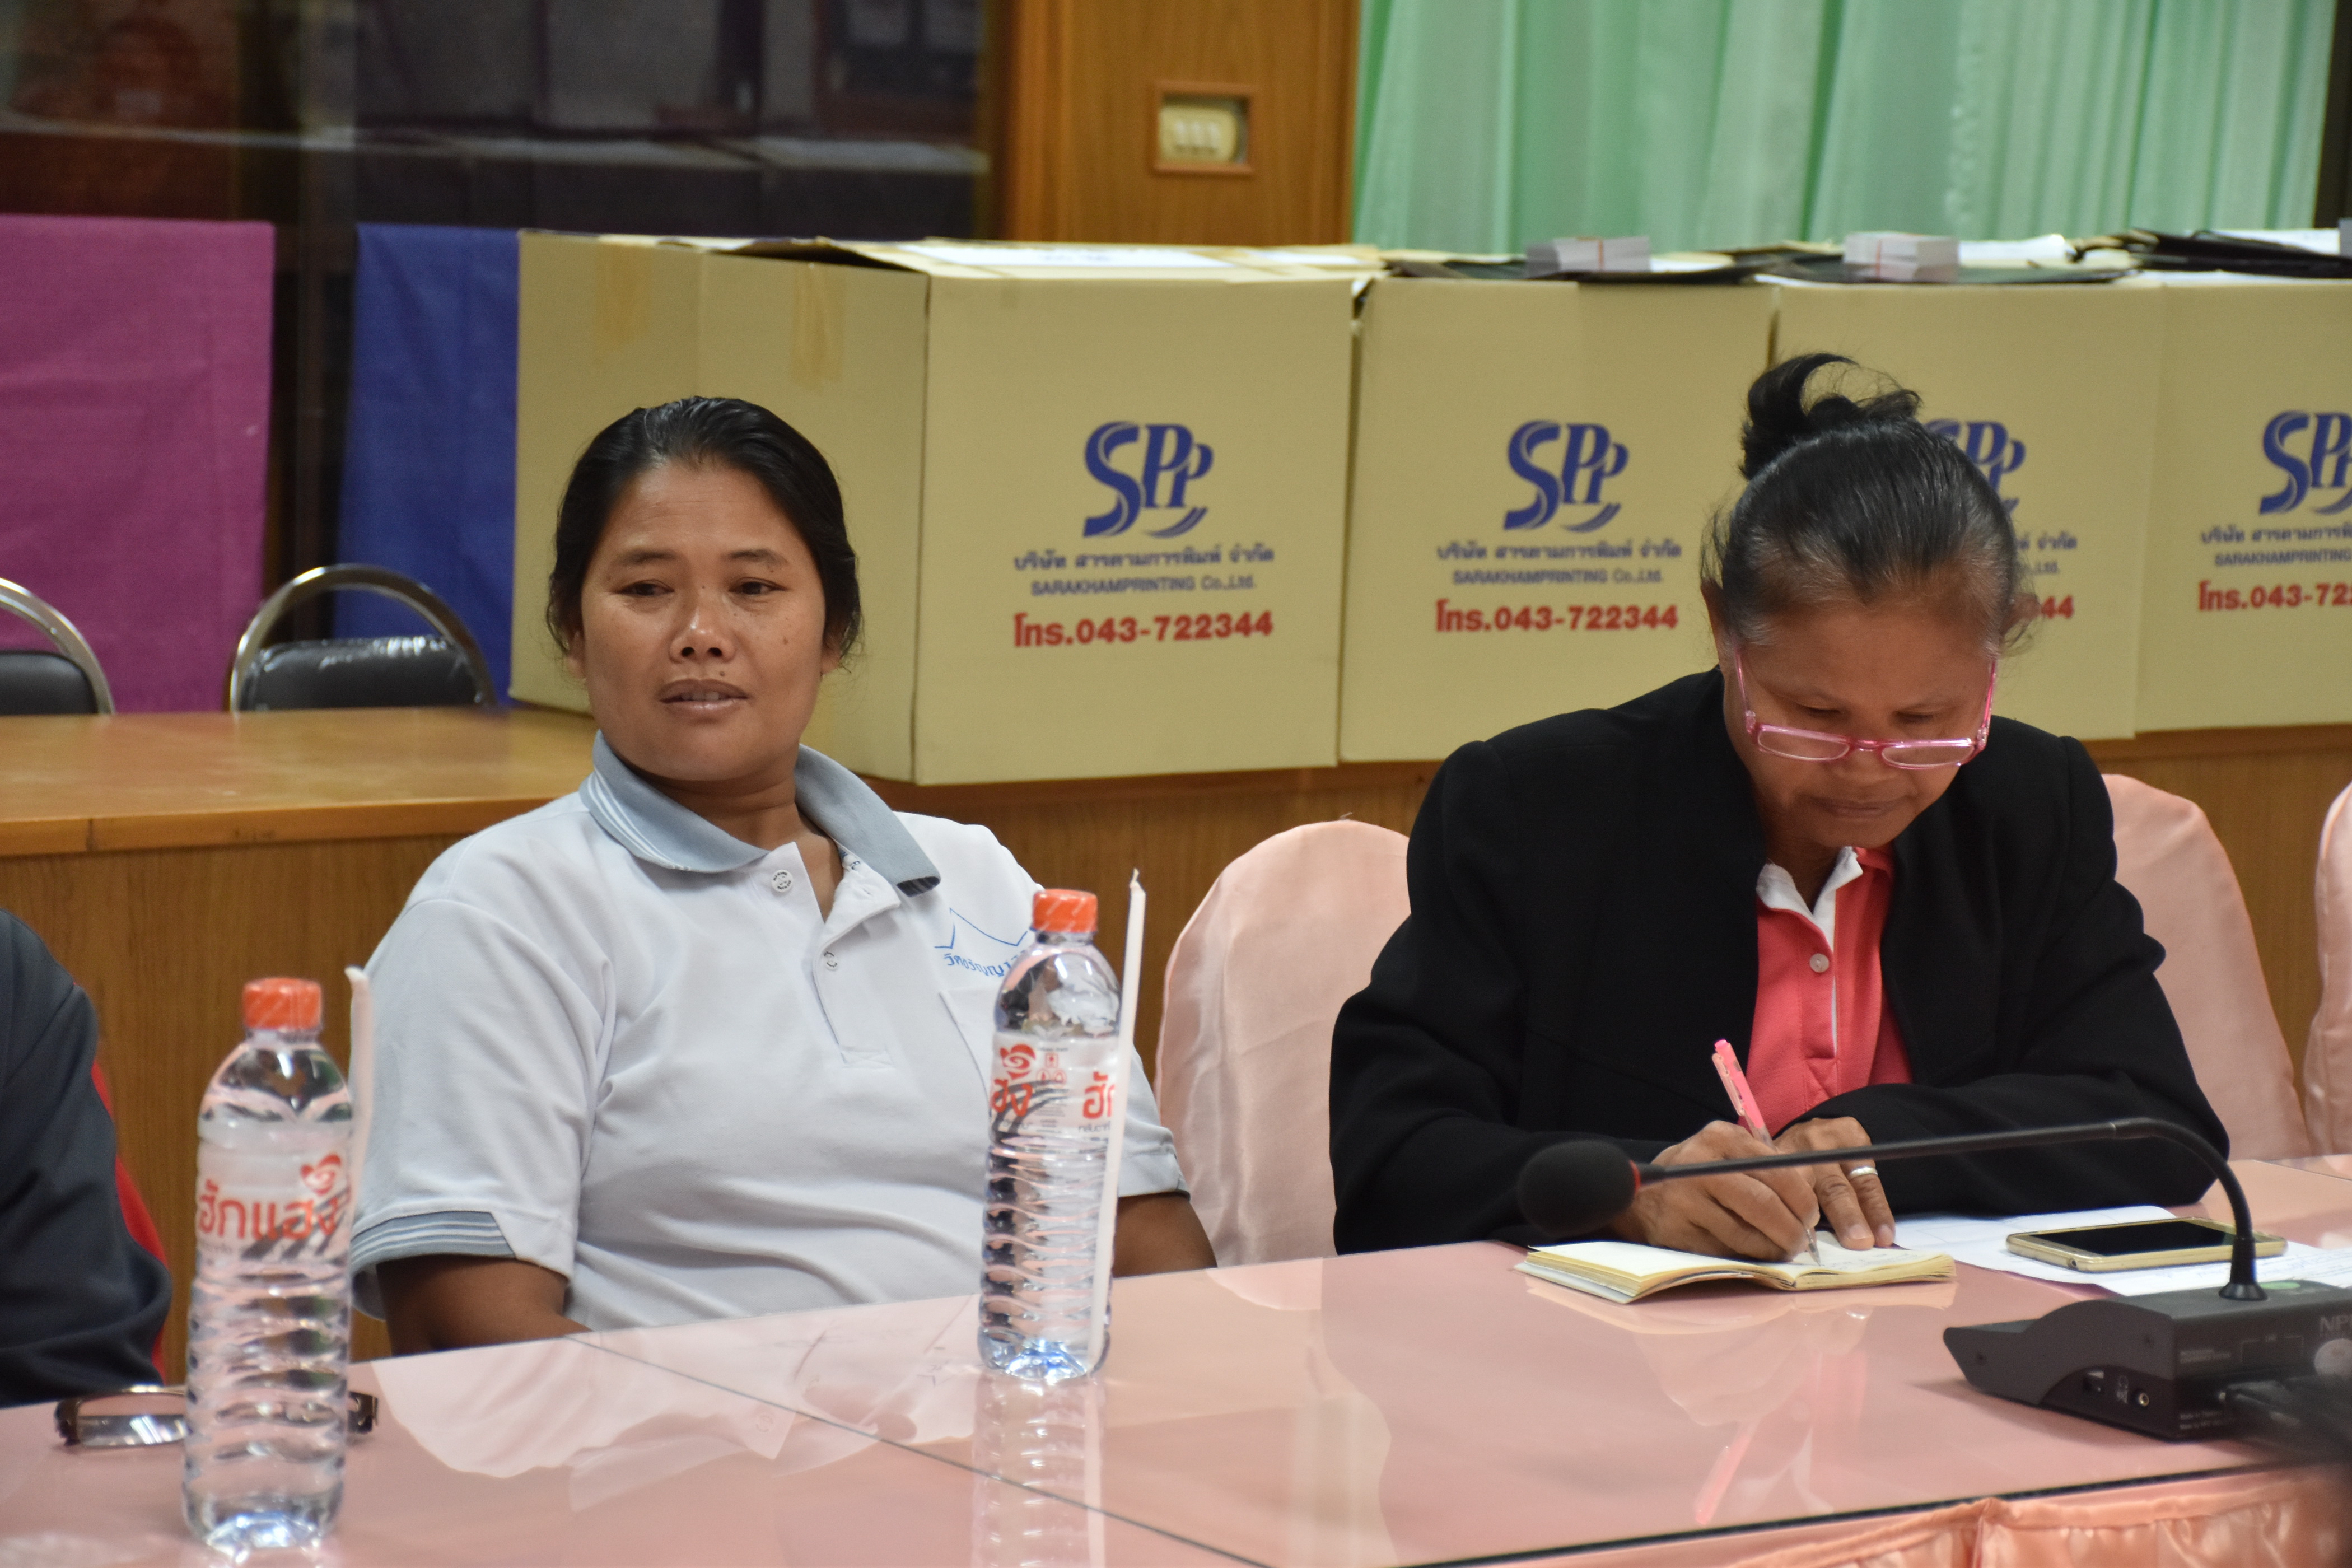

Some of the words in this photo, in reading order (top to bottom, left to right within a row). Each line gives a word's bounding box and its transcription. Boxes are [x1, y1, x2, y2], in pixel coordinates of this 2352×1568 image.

[2201, 524, 2244, 544] บริษัท
[1014, 549, 1067, 570] บริษัท
[1229, 542, 1274, 563] จำกัด
[1436, 540, 1487, 561] บริษัท
[1640, 538, 1682, 558] จำกัด
[1031, 575, 1196, 596] SARAKHAMPRINTING
[1453, 568, 1608, 585] SARAKHAMPRINTING
[2199, 579, 2352, 612] โทร.043-72
